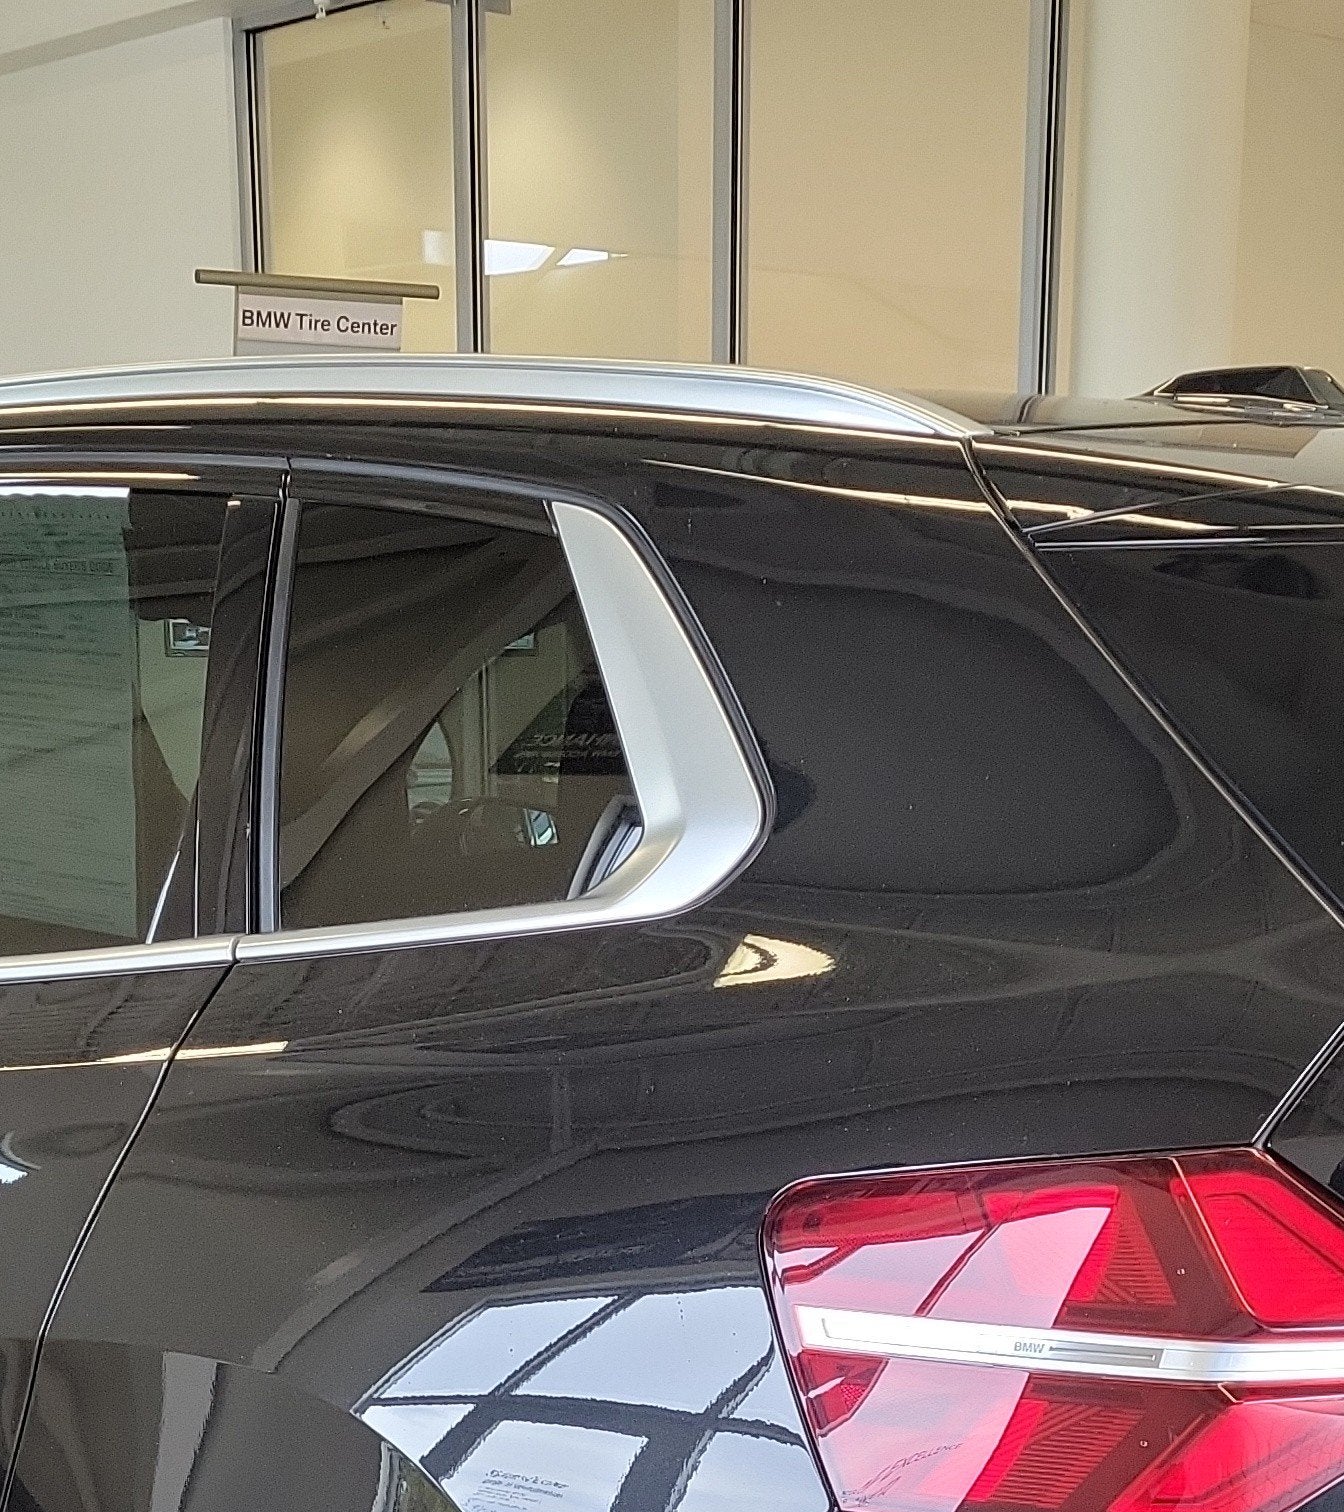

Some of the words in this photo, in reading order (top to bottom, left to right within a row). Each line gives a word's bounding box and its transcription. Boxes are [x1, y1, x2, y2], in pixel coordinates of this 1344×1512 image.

[241, 308, 292, 330] BMW
[295, 312, 332, 332] Tire
[336, 315, 398, 336] Center
[1014, 1341, 1046, 1354] BMW
